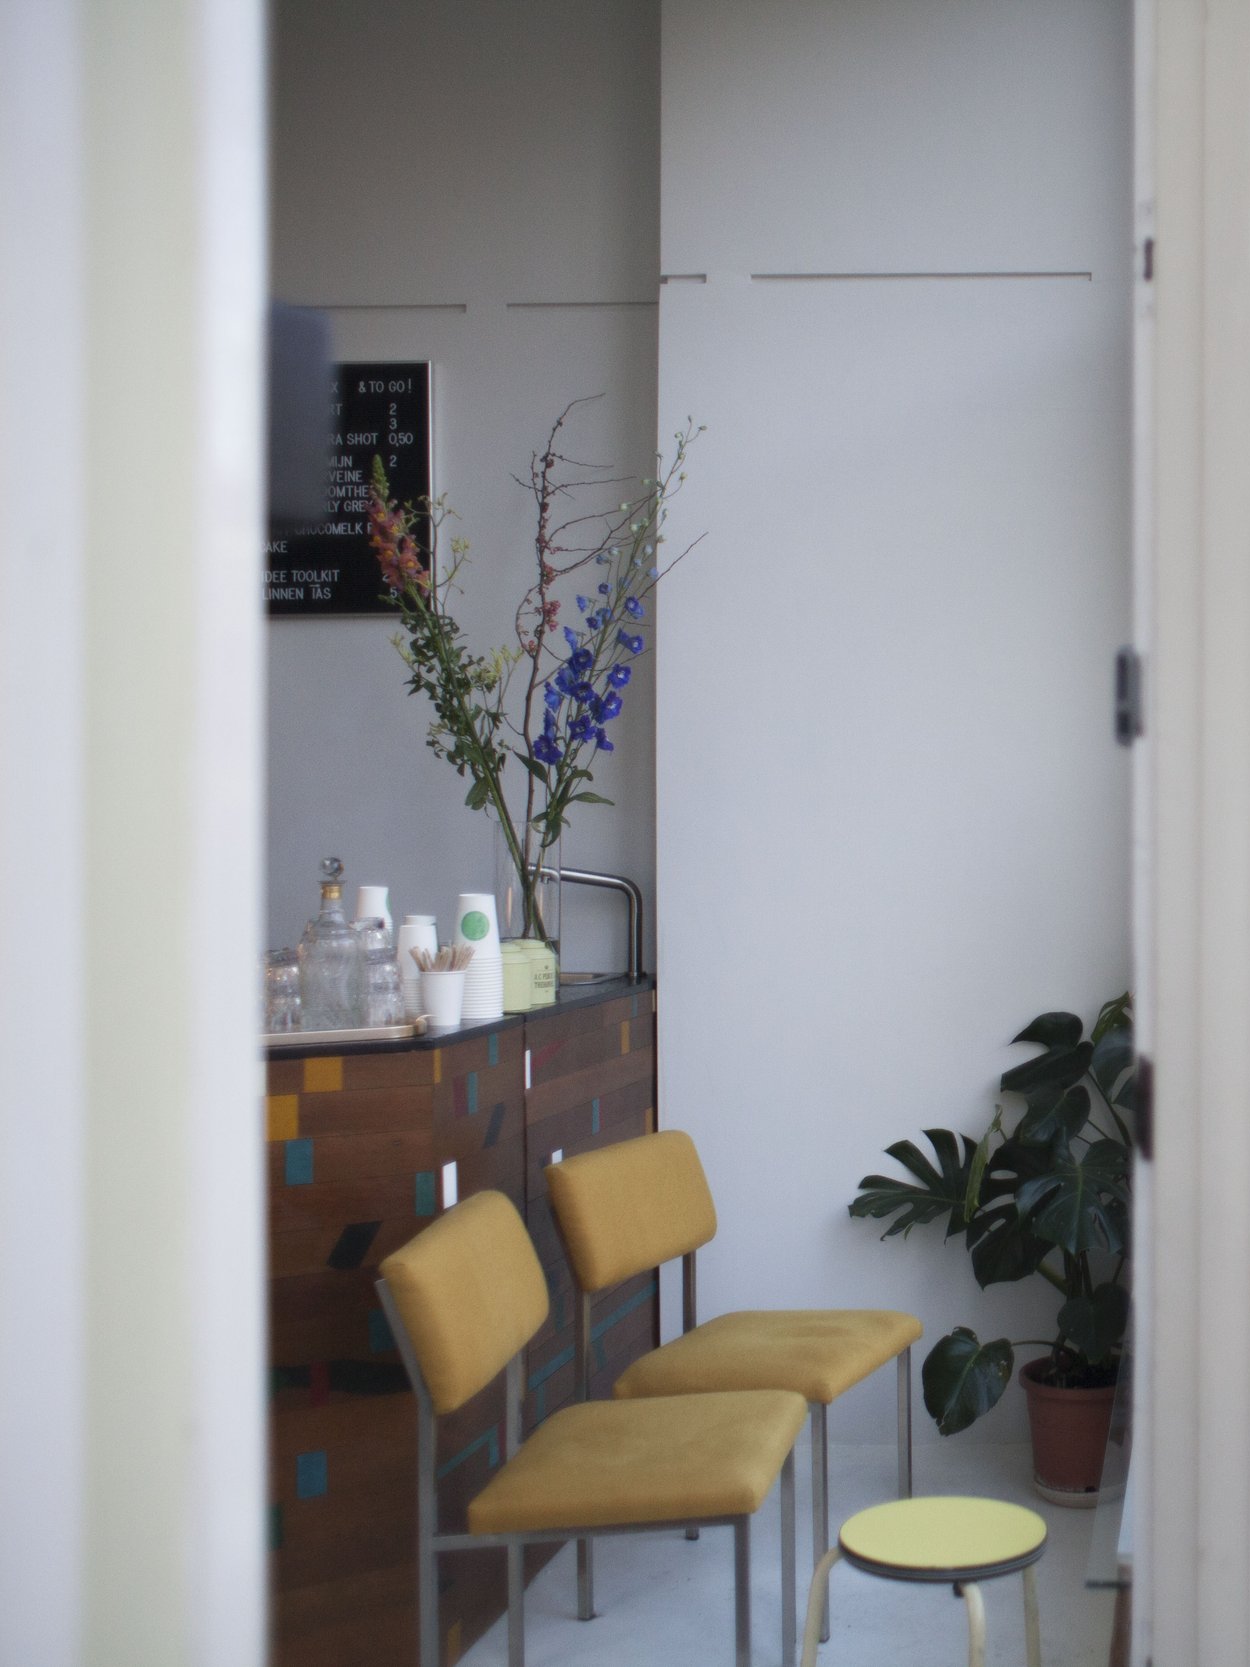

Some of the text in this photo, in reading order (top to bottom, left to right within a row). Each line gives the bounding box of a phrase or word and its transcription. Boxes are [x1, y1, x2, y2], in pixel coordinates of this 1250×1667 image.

[358, 381, 367, 393] &
[368, 381, 385, 393] TO
[389, 403, 397, 416] 2
[389, 418, 397, 430] 3
[346, 432, 379, 445] SHOT
[388, 432, 414, 447] 0,50
[328, 455, 397, 468] MIJN 2
[327, 470, 363, 482] VEINE
[327, 485, 373, 498] OMTHE
[263, 541, 288, 553] AKE
[291, 569, 340, 583] TOOLKIT
[389, 587, 398, 599] 5
